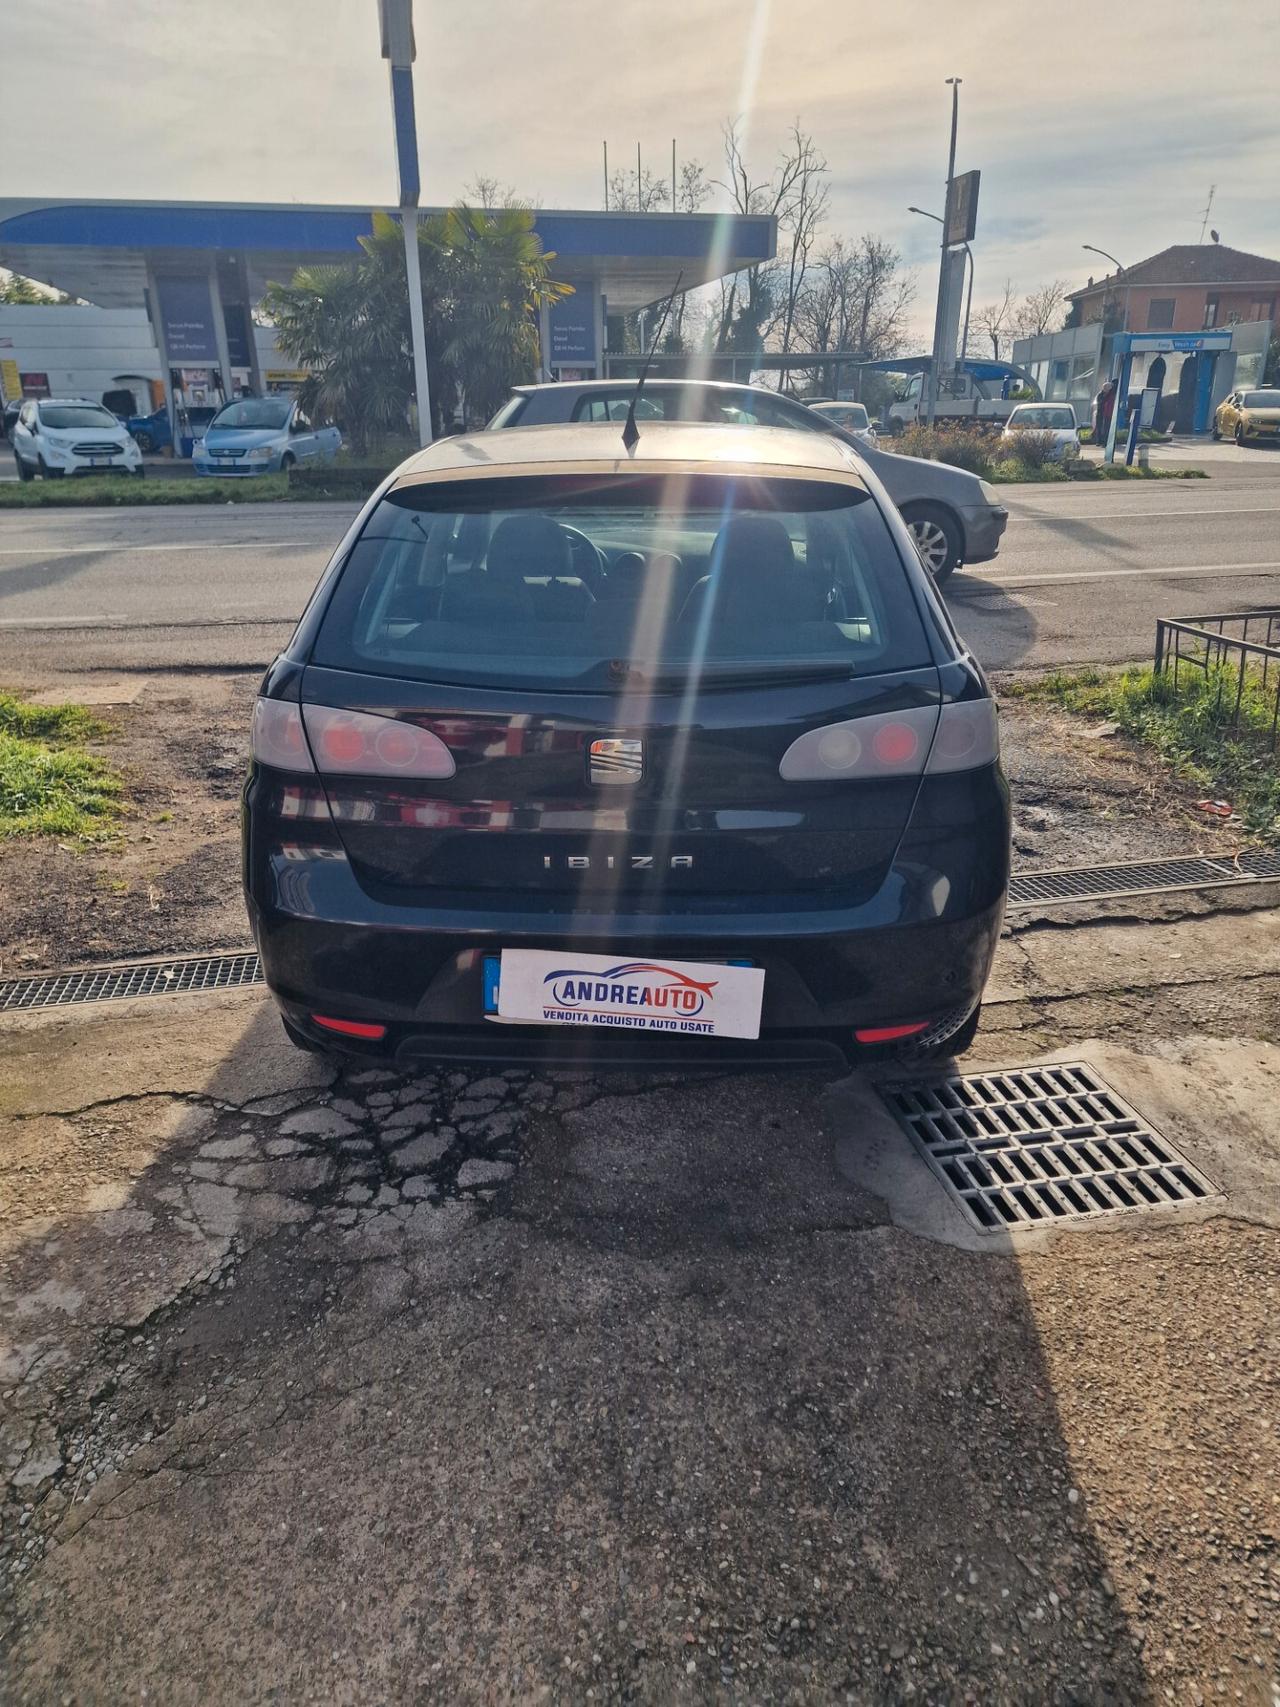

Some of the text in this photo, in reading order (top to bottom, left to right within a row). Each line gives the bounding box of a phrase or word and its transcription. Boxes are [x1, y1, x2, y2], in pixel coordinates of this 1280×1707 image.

[544, 856, 693, 868] IBIZA
[562, 980, 697, 1010] ANDREAUTO
[543, 1010, 589, 1022] VENDITA
[591, 1014, 646, 1027] ACQUISTO
[648, 1019, 678, 1031] AUTO
[680, 1022, 715, 1033] USATE
